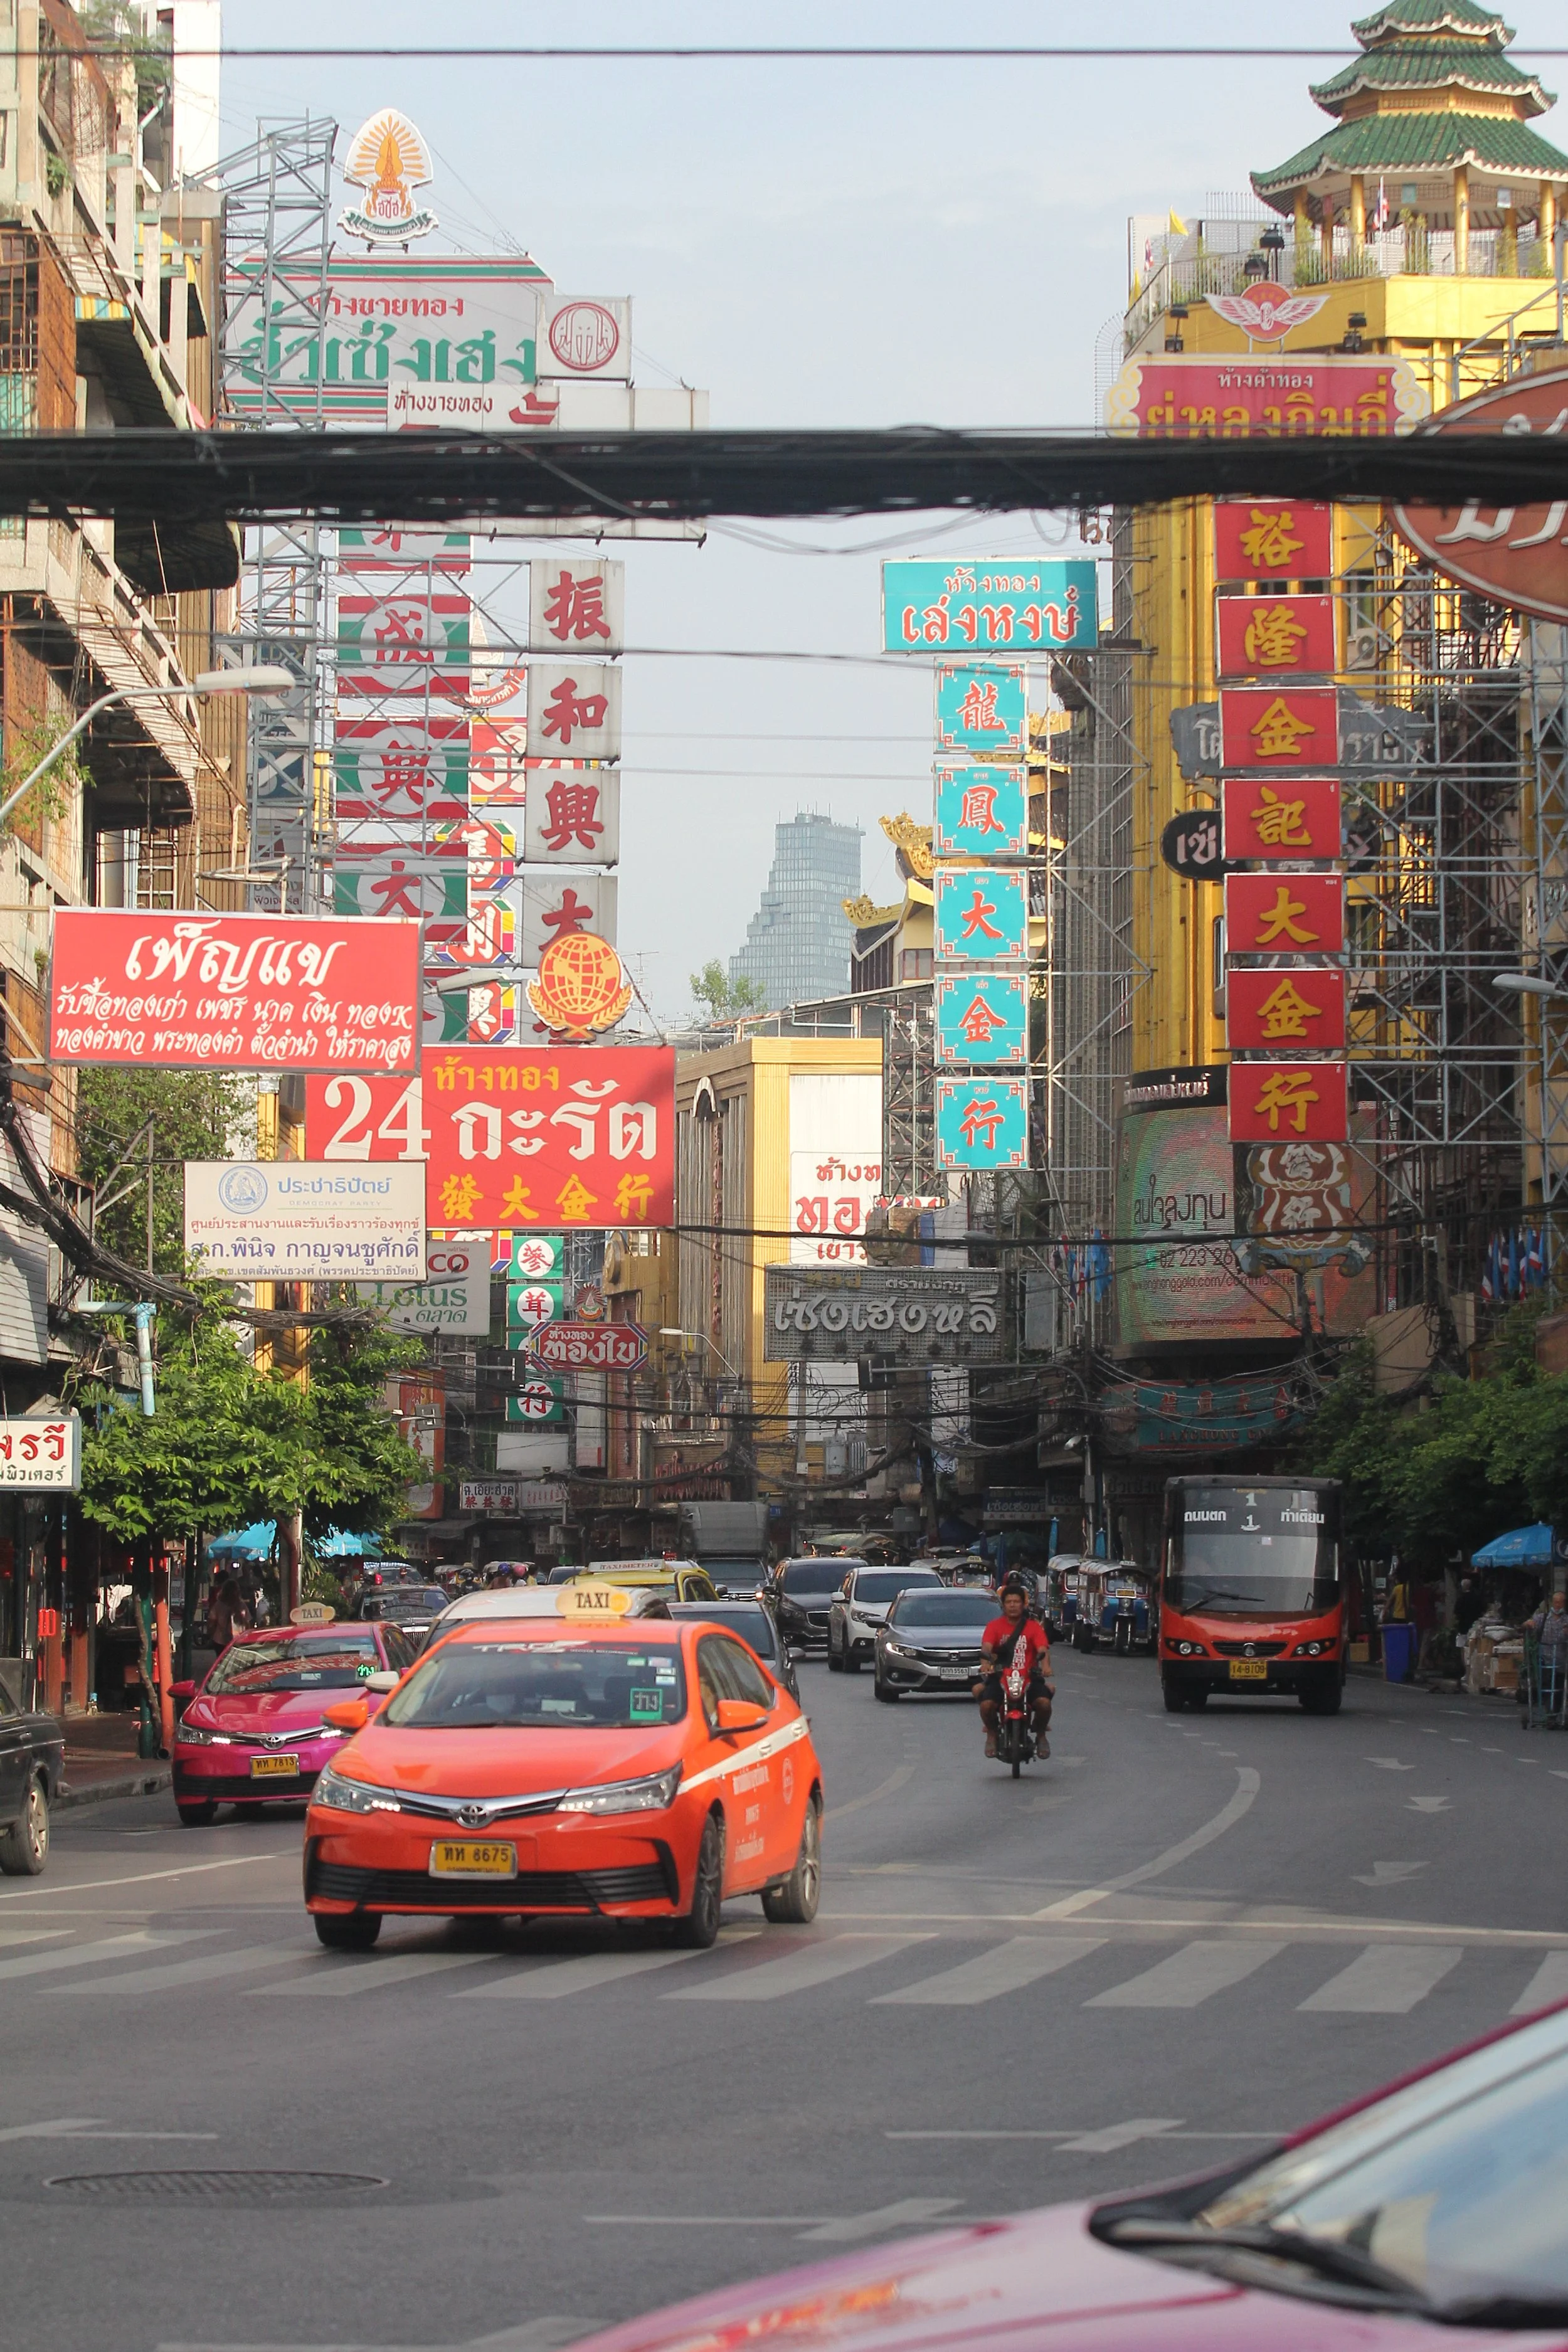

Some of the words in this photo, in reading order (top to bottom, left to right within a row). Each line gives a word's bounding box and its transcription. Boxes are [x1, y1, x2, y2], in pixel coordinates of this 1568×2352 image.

[307, 297, 464, 317] หางขายทอง
[1217, 367, 1313, 389] ห้างค้าทอง
[395, 390, 493, 414] ห้างขายทอง
[1146, 375, 1387, 438] ย่หลงกิมกี่
[944, 565, 1041, 594] ห้างทอง
[901, 585, 1082, 644] เล่งหงษ์
[125, 919, 347, 993] เพ็ญแข
[57, 977, 188, 1022] รับซื้อทองเก่า
[196, 995, 248, 1021] เพชร
[302, 991, 342, 1024] เงิน
[55, 1022, 146, 1056] ทองคำขาว
[151, 1027, 243, 1058] พระทองคำ
[251, 1021, 318, 1060] ตั๋วจำนำ
[326, 1025, 411, 1069] ให้ราคาสูง
[432, 1056, 559, 1091] ห้างทอง
[324, 1076, 432, 1161] 24
[451, 1079, 657, 1160] กะรัต
[816, 1157, 881, 1182] ห้างท
[278, 1177, 392, 1194] ประชาธิปัตย์
[439, 1173, 655, 1221] 發大金行
[191, 1215, 420, 1234] ศูนย์ประสานงานและรับเรื่องราวร้องทุกข์
[287, 1231, 420, 1266] กาญจนชูศักดิ์
[817, 1242, 867, 1260] เยาว
[319, 1263, 419, 1277] (พรรคประชาธิปัตย์)
[373, 1282, 467, 1306] Lotus
[416, 1310, 467, 1323] ตลาด
[548, 1327, 595, 1340] ห้างทอง
[543, 1331, 636, 1364] ทองใบ
[1184, 1510, 1227, 1522] ถนนตก
[576, 1592, 610, 1609] TAXI
[302, 1608, 323, 1619] TAXI
[273, 1757, 294, 1767] 7813
[474, 1847, 509, 1862] 8675
